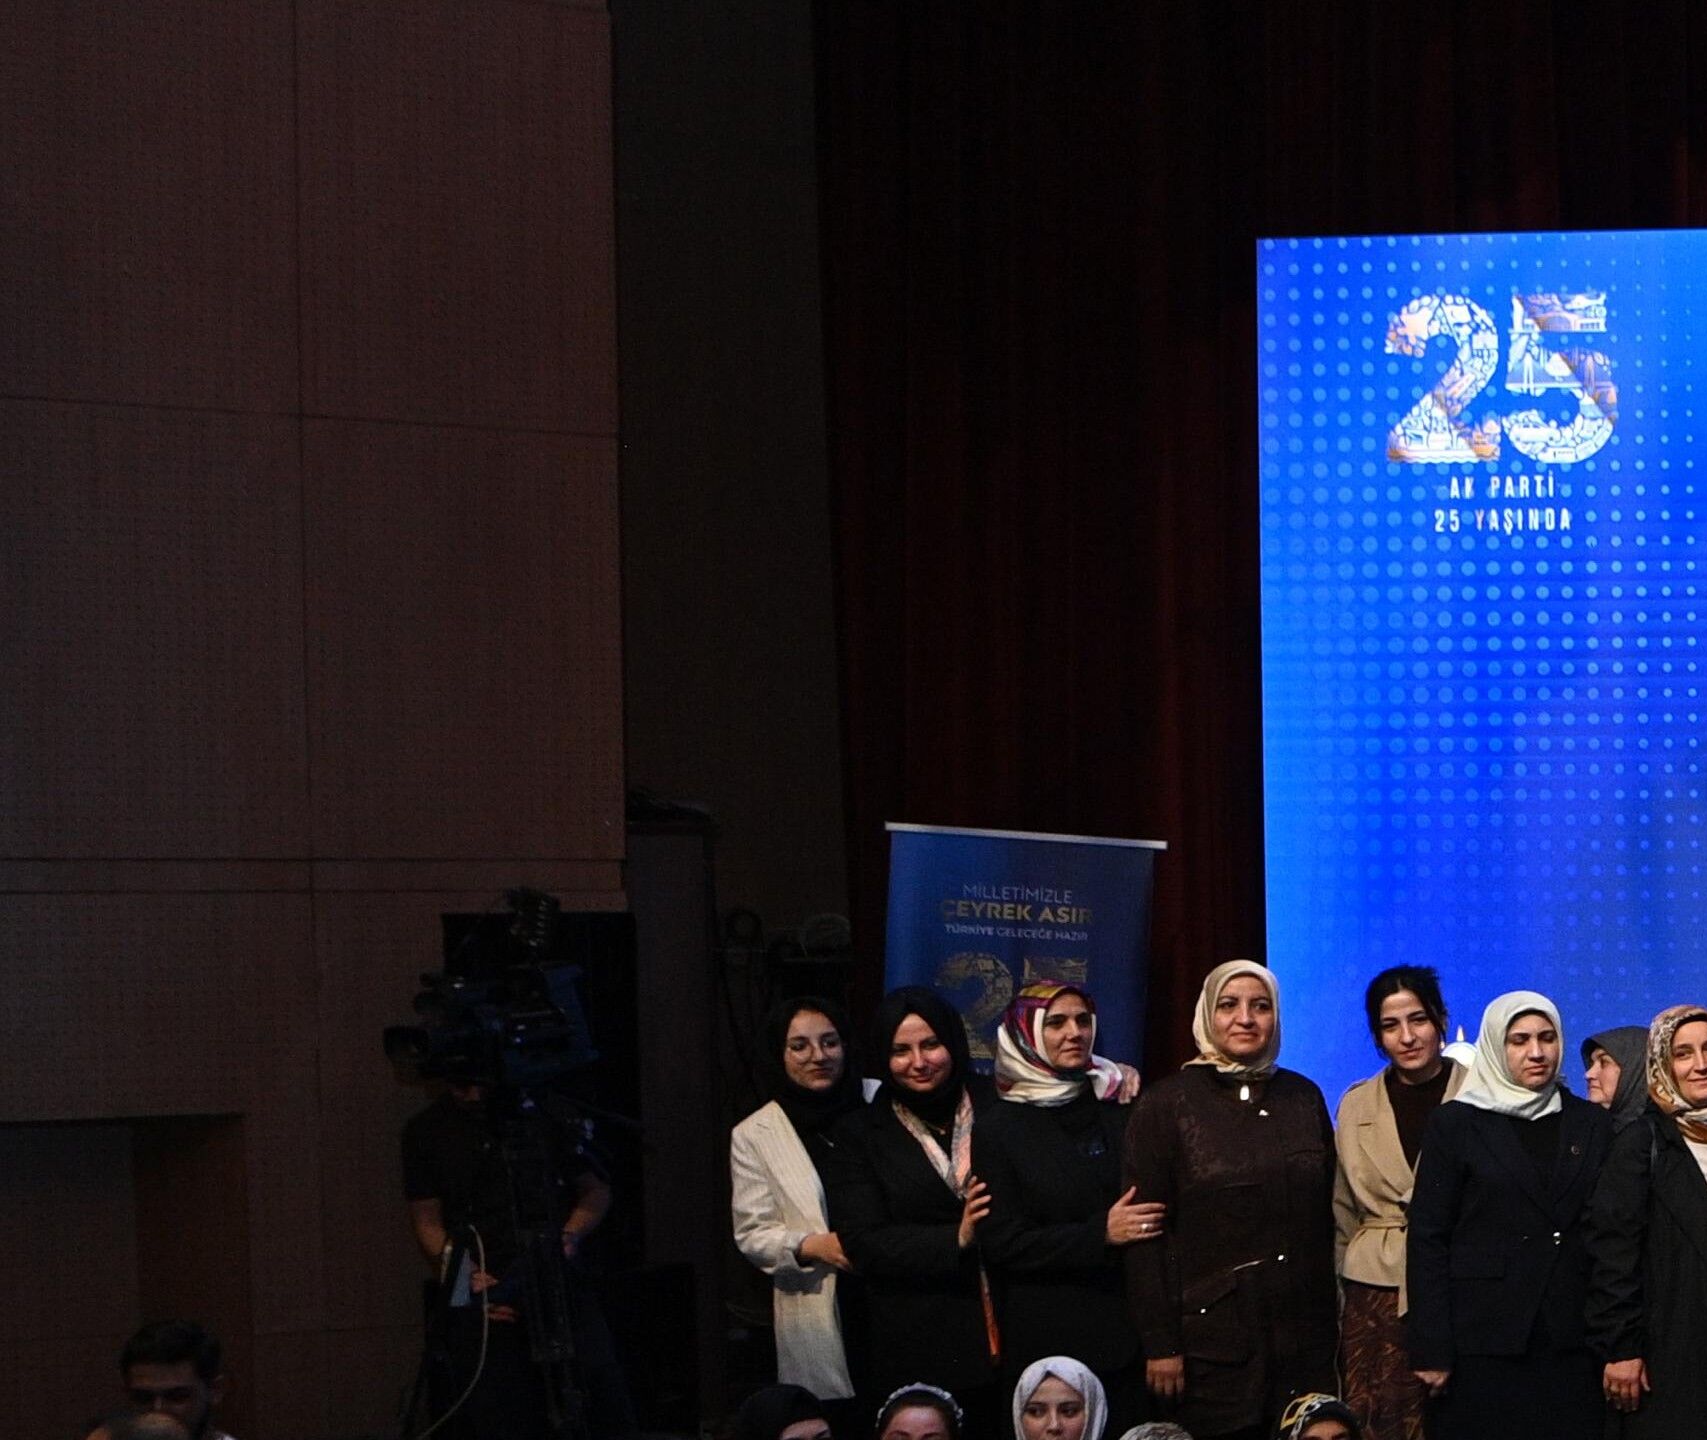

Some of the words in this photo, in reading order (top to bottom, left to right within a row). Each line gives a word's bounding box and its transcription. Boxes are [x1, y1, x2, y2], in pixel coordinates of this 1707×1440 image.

[1384, 293, 1619, 464] 25
[1450, 476, 1474, 499] AK
[1490, 470, 1555, 498] PARTİ
[1434, 508, 1461, 532] 25
[1475, 507, 1571, 535] YAŞINDA
